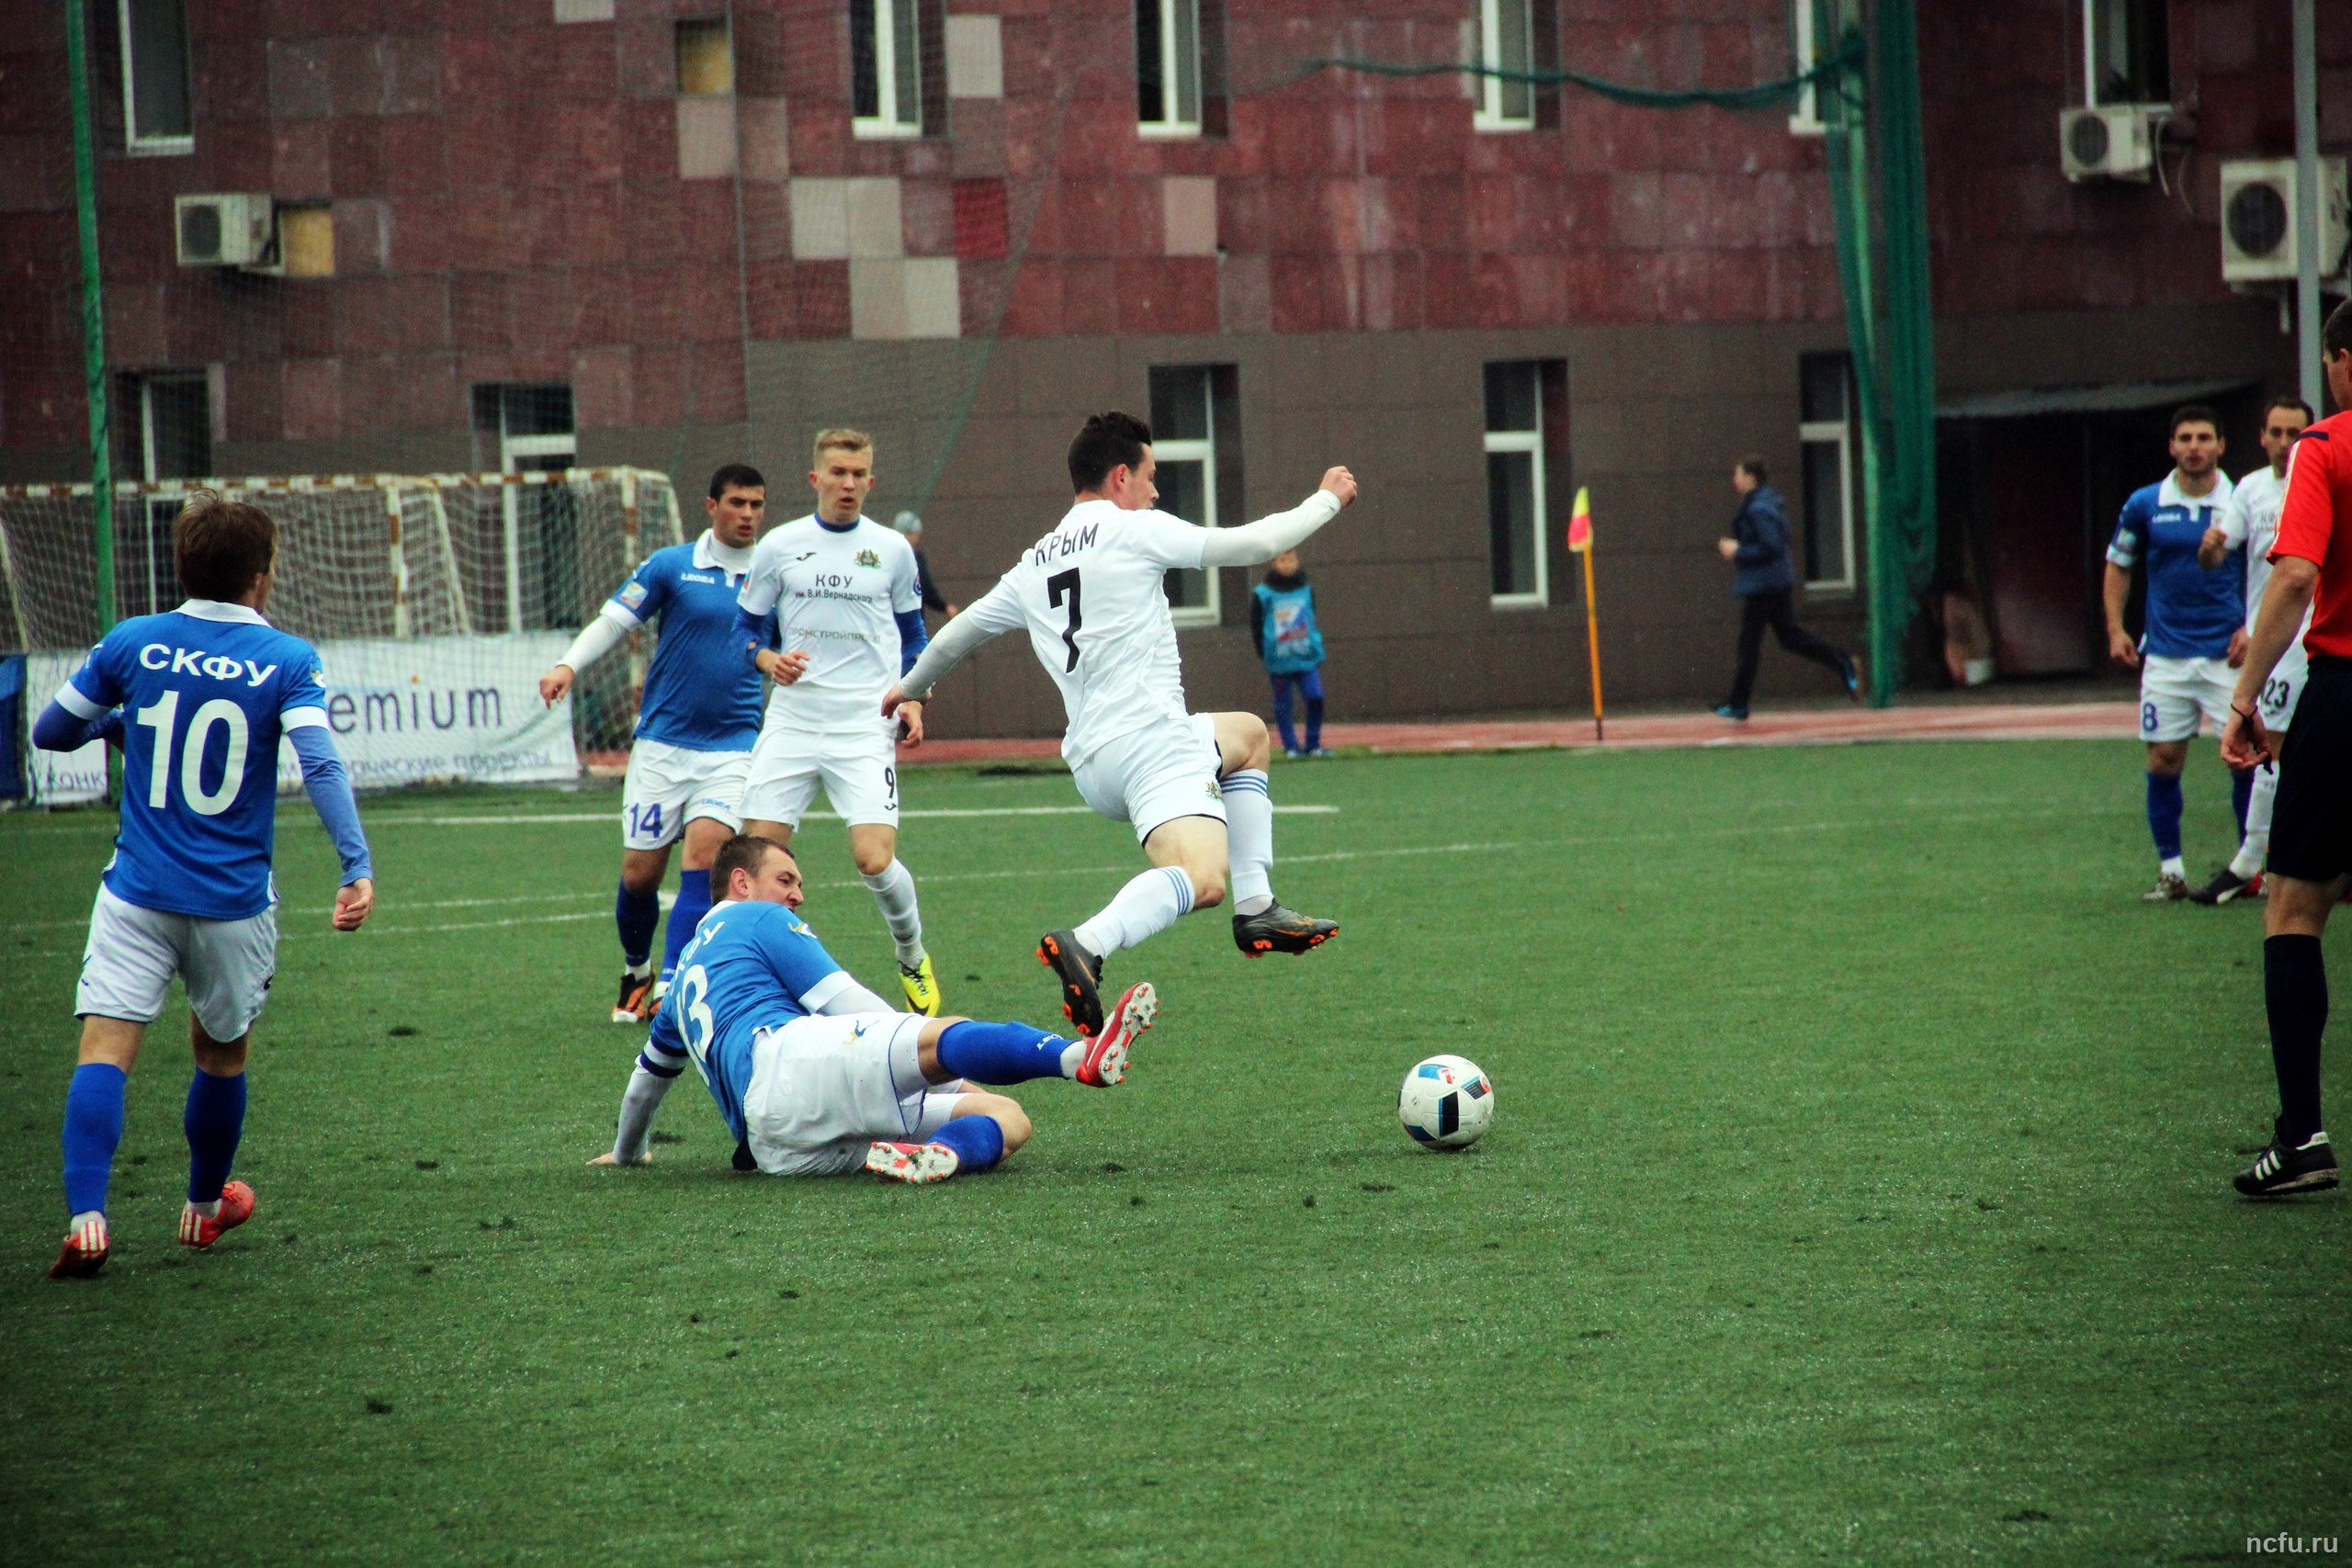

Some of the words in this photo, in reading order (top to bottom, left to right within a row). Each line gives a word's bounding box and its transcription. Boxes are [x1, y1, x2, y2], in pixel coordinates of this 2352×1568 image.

[1035, 523, 1099, 566] КРЫМ
[815, 574, 853, 588] КФУ
[1047, 567, 1081, 673] 7
[140, 643, 277, 687] СКФУ
[328, 674, 502, 734] emium
[2143, 702, 2158, 731] 8
[137, 690, 249, 816] 10
[885, 766, 895, 799] 9
[629, 803, 663, 839] 14
